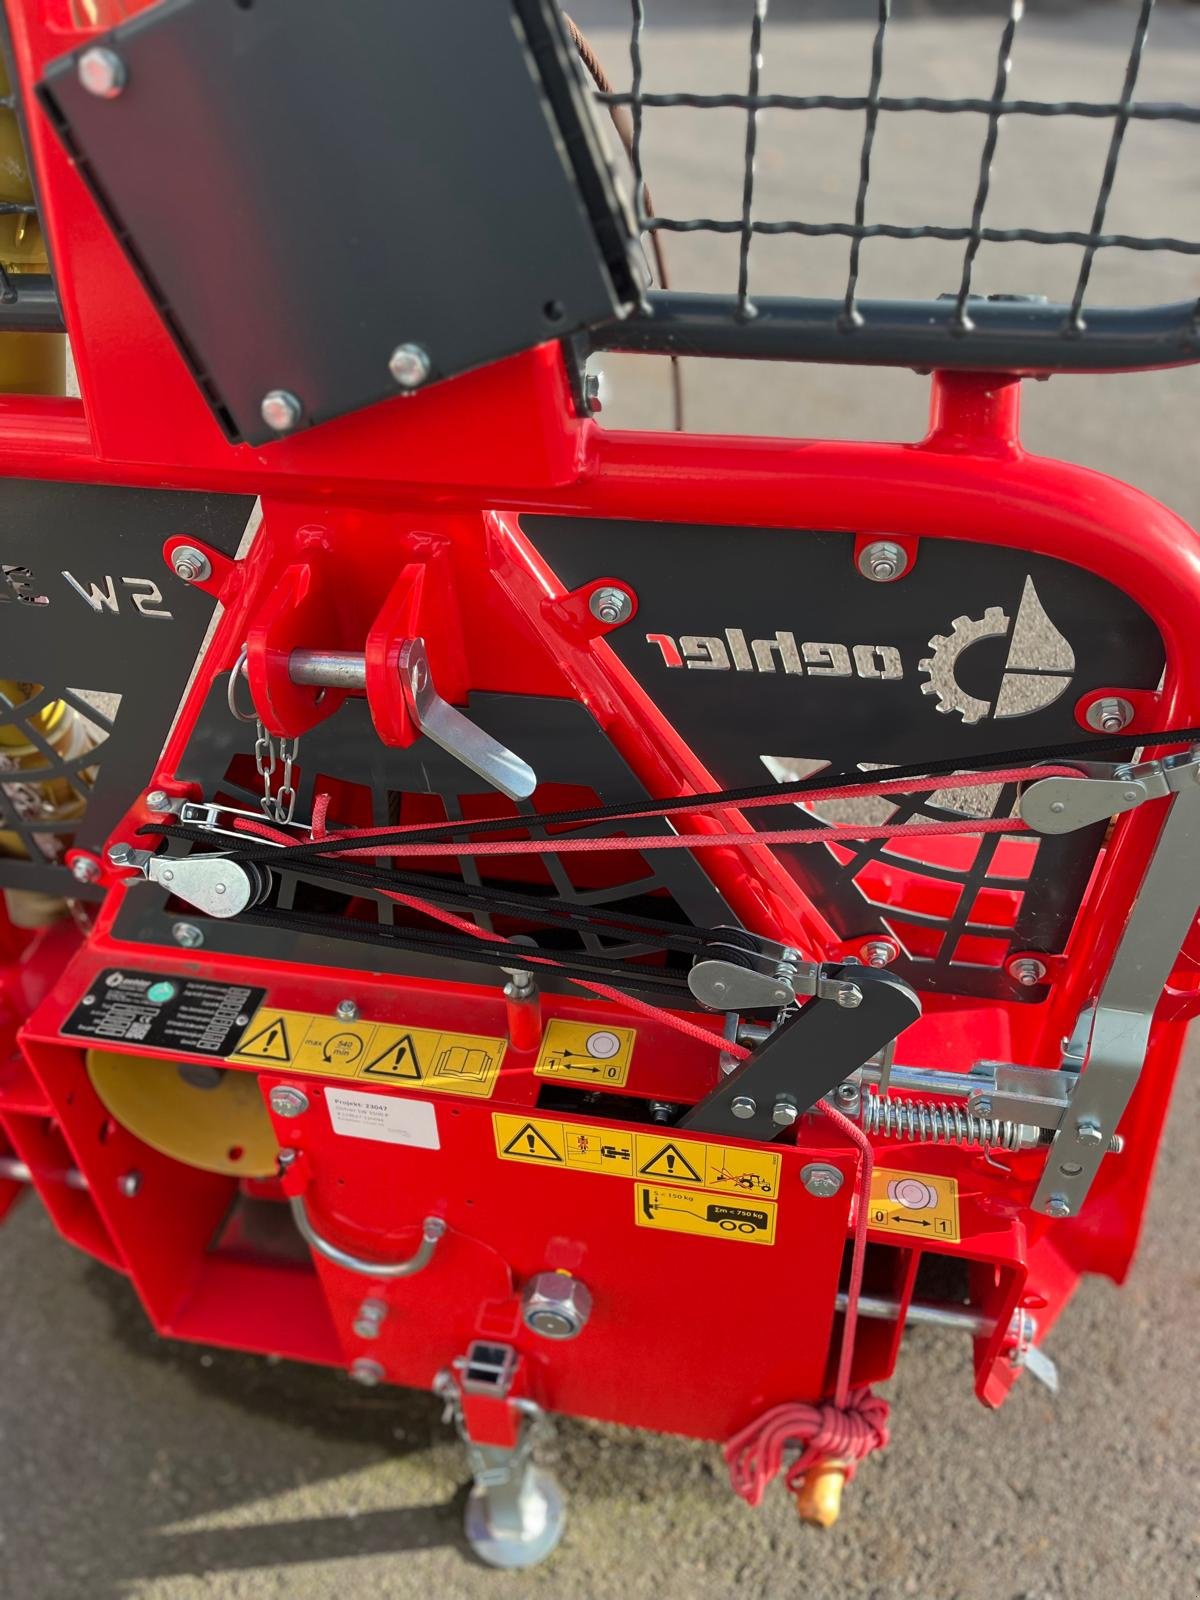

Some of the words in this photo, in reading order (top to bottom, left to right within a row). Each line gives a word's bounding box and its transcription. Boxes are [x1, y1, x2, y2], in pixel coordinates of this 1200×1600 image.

[304, 1039, 322, 1047] max
[548, 1059, 555, 1069] 1
[608, 1067, 616, 1078] 0
[736, 1209, 752, 1217] 750
[753, 1211, 763, 1219] kg
[875, 1210, 884, 1222] 0
[939, 1221, 946, 1232] 1
